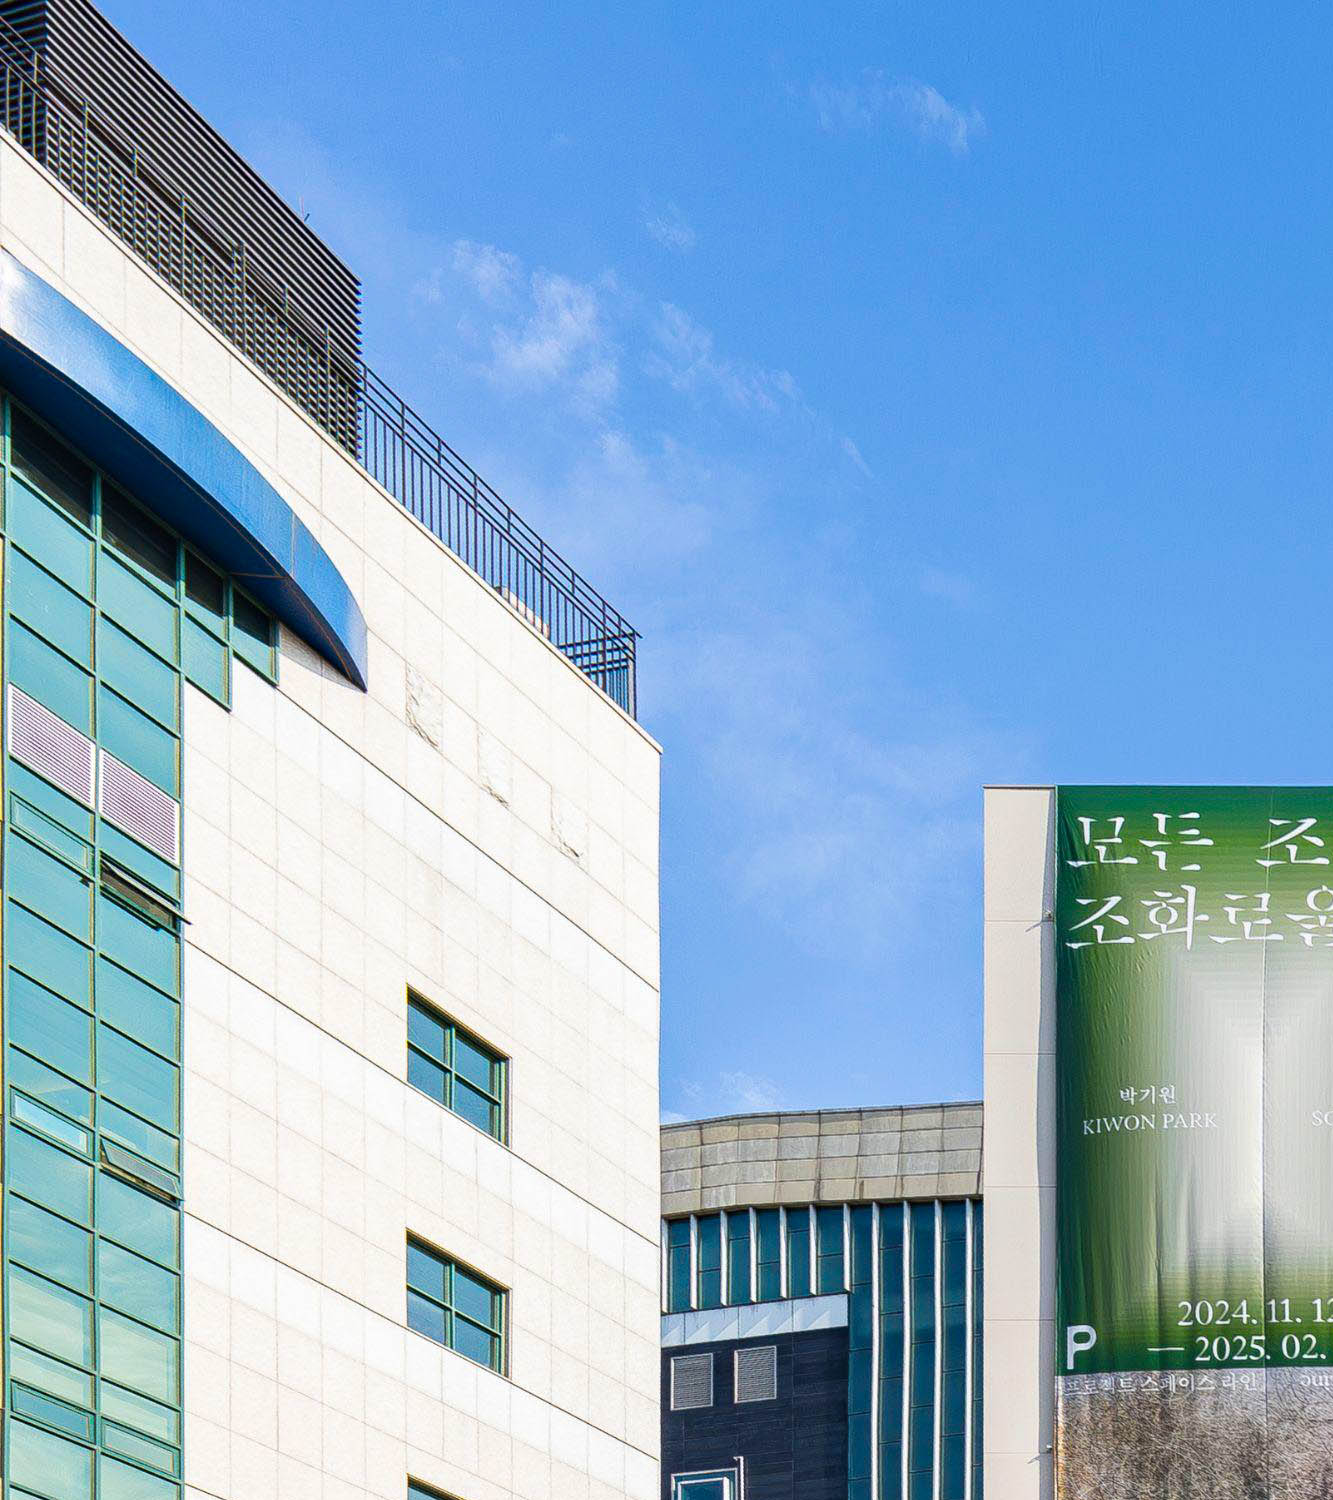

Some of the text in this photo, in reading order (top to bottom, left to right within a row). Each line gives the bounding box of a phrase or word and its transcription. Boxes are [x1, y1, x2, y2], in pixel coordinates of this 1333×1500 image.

[1065, 811, 1215, 872] 모든
[1119, 1084, 1178, 1106] 박기원
[1082, 1111, 1219, 1136] KIWON PARK
[1177, 1299, 1258, 1327] 2024.
[1266, 1299, 1302, 1324] 11.
[1066, 1324, 1097, 1370] P
[1194, 1335, 1271, 1362] 2025.
[1281, 1335, 1327, 1360] 02.
[1064, 1372, 1258, 1396] 프로젝트 스페이스 라인
